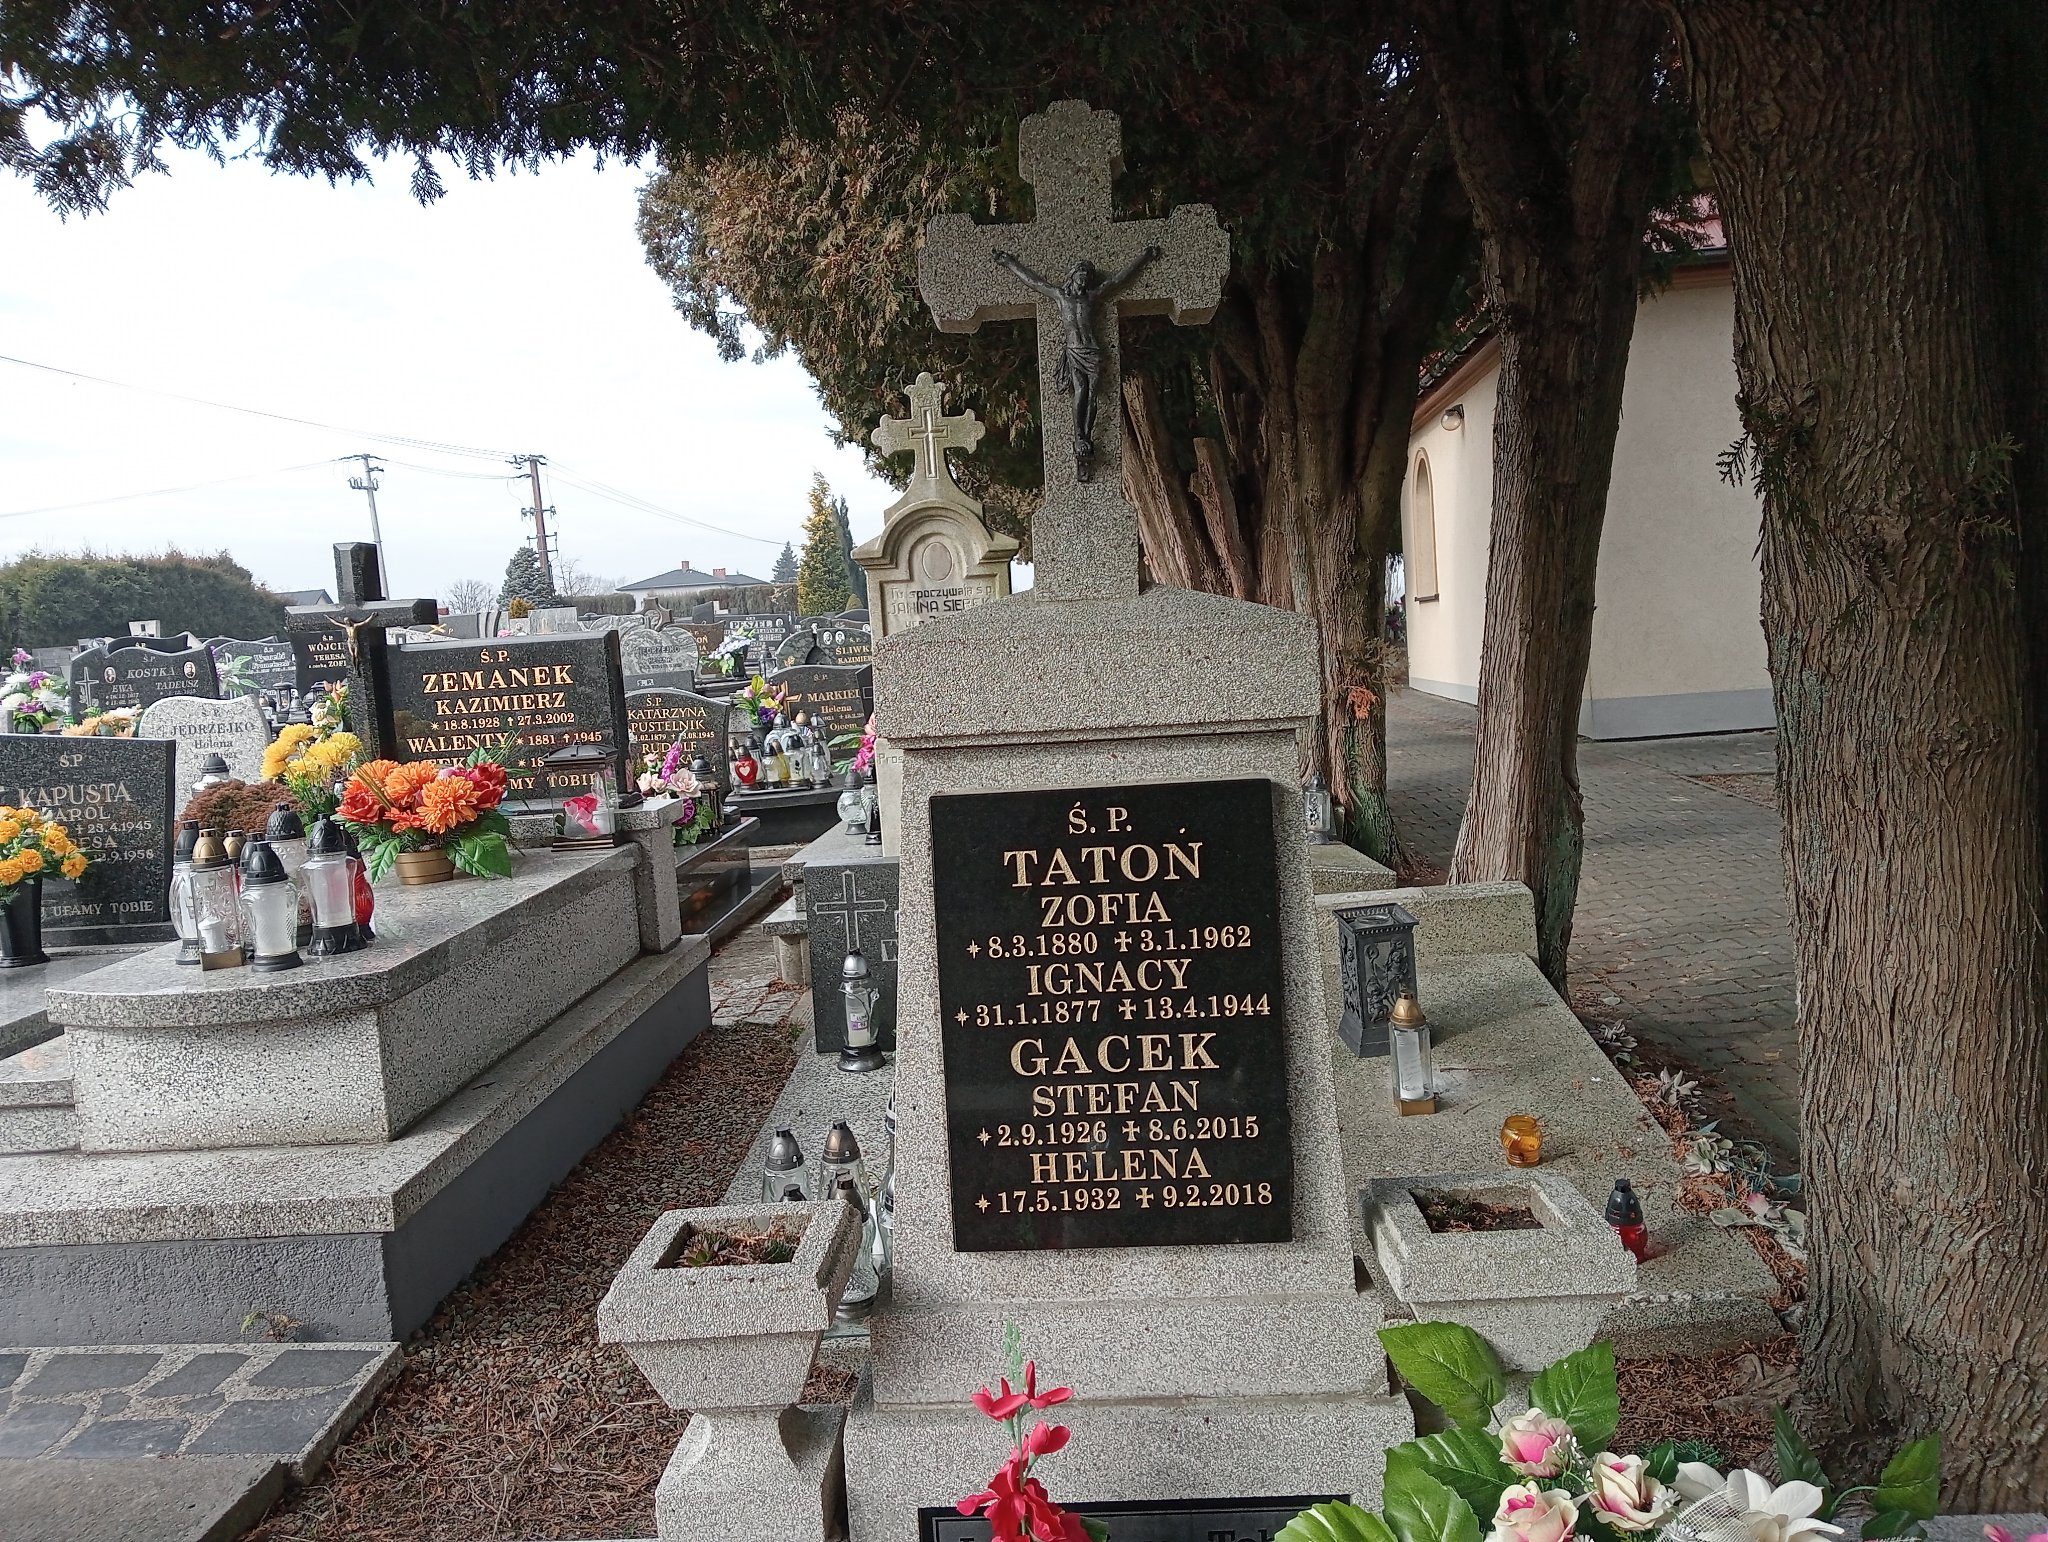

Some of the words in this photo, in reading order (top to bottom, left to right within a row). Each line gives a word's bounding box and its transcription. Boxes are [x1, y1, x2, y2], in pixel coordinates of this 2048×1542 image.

[835, 644, 872, 655] ŚLIWK
[127, 666, 175, 679] KOSTKA
[422, 664, 574, 694] ZEMANEK
[112, 684, 133, 693] EWA
[156, 680, 199, 690] TADEUSZ
[435, 692, 566, 716] KAZIMIERZ
[627, 706, 706, 720] KATARZYNA
[821, 705, 852, 714] Helena
[443, 717, 500, 731] 18.8.1928
[517, 712, 575, 726] 27.3.2002
[630, 719, 706, 733] PUSTELNIK
[406, 732, 509, 754] WALENTY
[528, 734, 555, 746] 1881
[574, 731, 602, 744] 1945
[642, 741, 697, 754] RUDLF
[18, 782, 133, 808] KAPUSTA
[55, 805, 111, 823] AROL
[1107, 807, 1133, 832] P.
[1003, 827, 1203, 888] TATOŃ
[53, 903, 103, 918] UFAMY
[110, 900, 154, 914] TOBIE
[1041, 891, 1172, 928] ZOFIA
[988, 932, 1098, 959] 8.3.1880
[1140, 925, 1252, 952] 3.1.1962
[1026, 958, 1193, 996] IGNACY
[976, 999, 1101, 1027] 31.1.1877
[1144, 993, 1271, 1020] 13.4.1944
[1010, 1032, 1220, 1077] GACEK
[1032, 1080, 1201, 1117] STEFAN
[997, 1120, 1107, 1146] 2.9.1926
[1149, 1115, 1259, 1141] 8.6.2015
[1029, 1147, 1212, 1184] HELENA
[998, 1187, 1122, 1213] 17.5.1932
[1162, 1182, 1273, 1207] 9.2.2018
